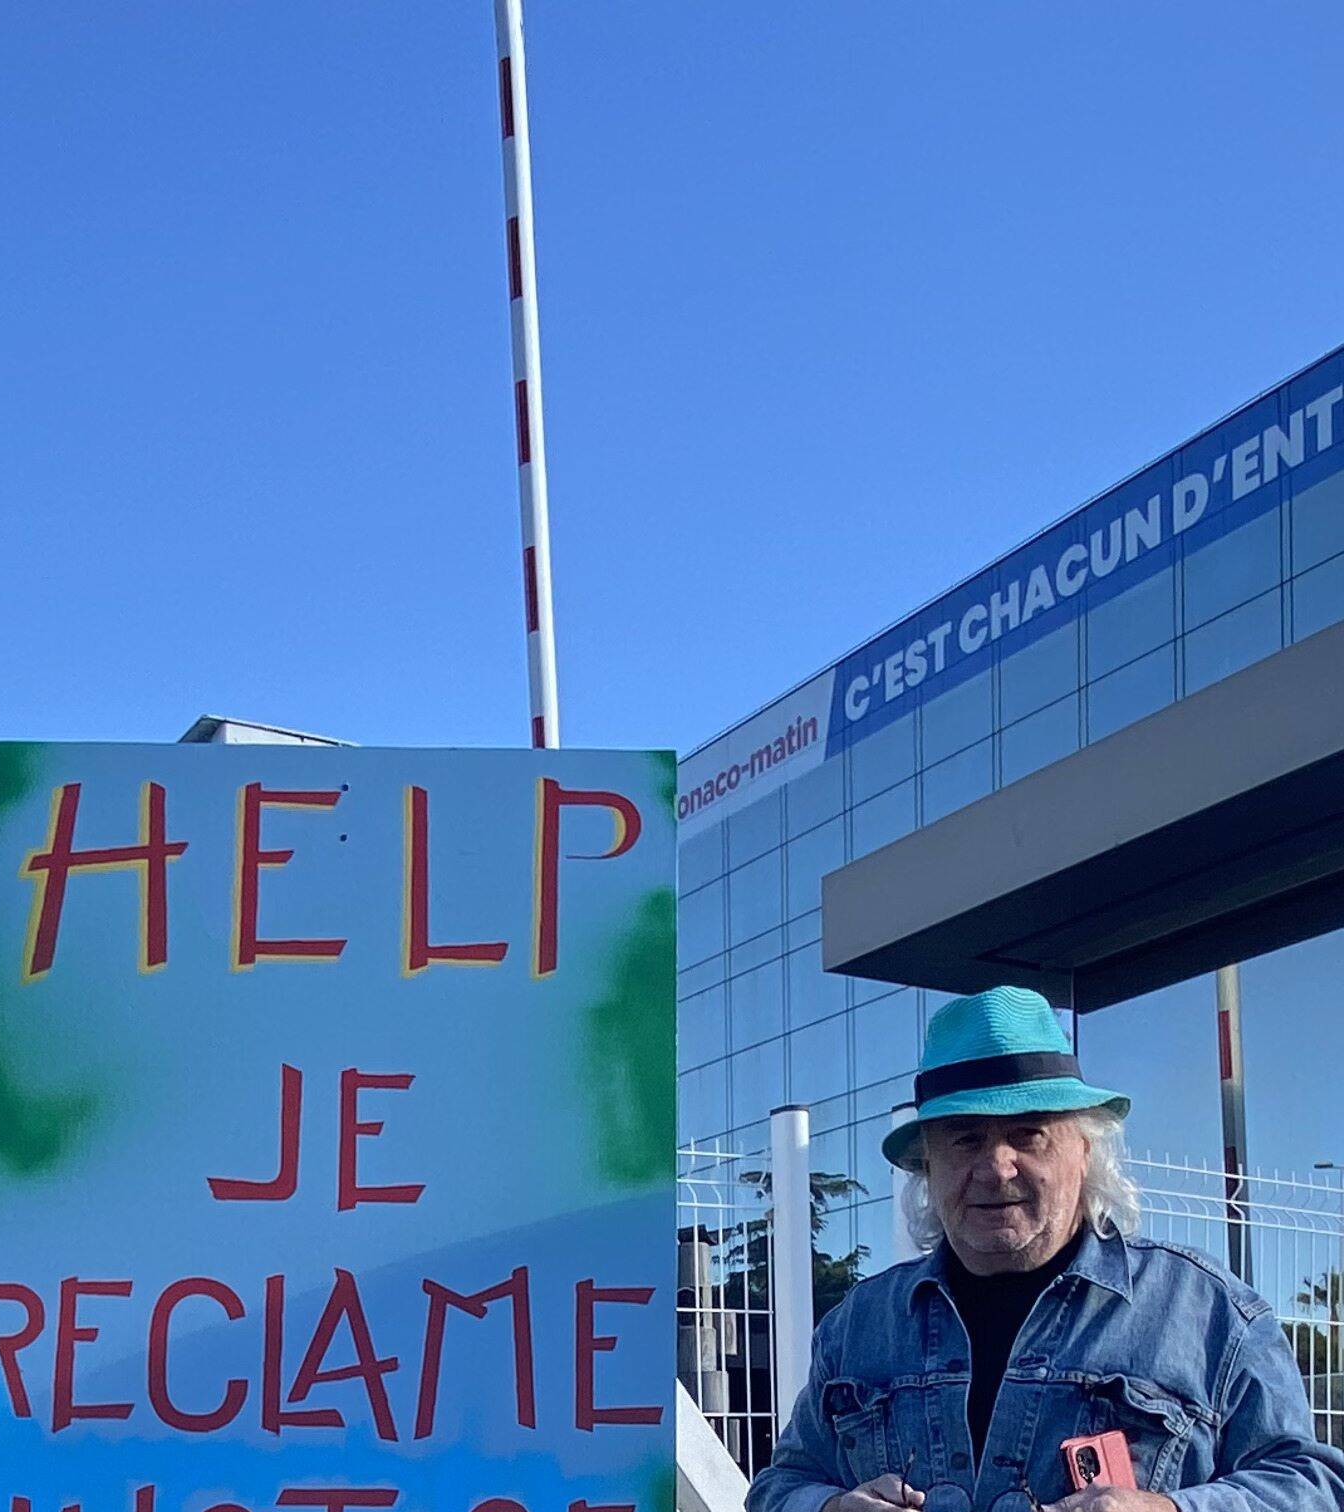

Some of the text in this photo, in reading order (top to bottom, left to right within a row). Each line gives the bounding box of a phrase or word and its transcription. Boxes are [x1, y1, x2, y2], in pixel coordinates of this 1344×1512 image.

[844, 621, 952, 722] C'EST
[958, 494, 1162, 655] CHACUN
[677, 714, 818, 820] onaco-matin
[20, 776, 642, 984] HELP
[206, 1062, 426, 1212] JE
